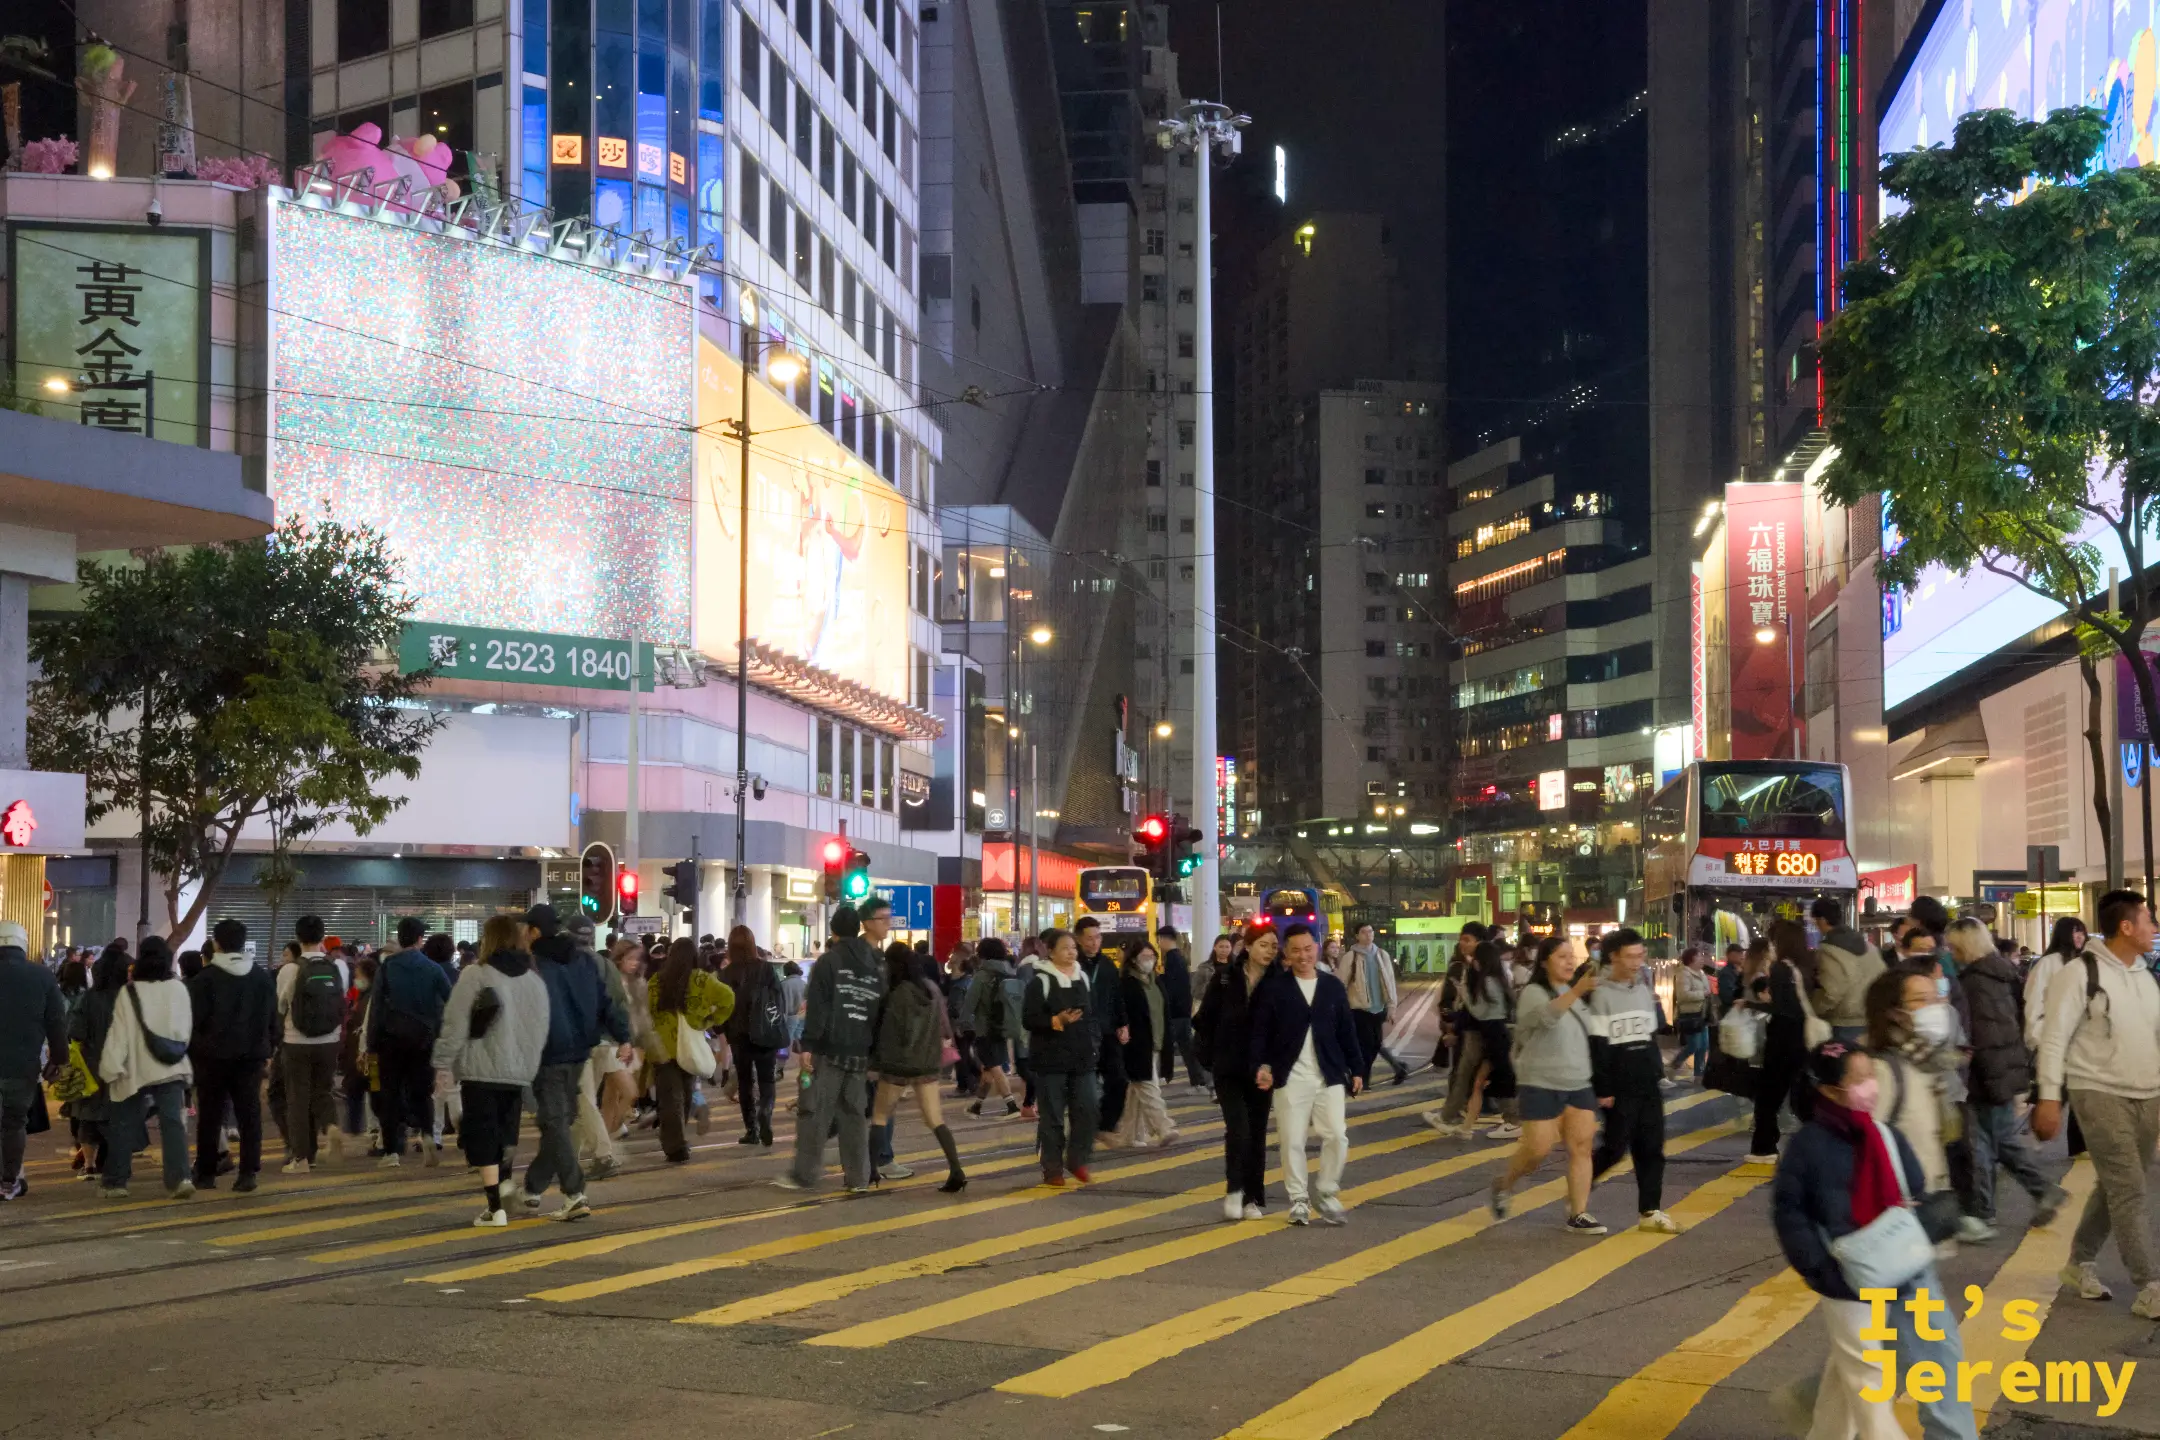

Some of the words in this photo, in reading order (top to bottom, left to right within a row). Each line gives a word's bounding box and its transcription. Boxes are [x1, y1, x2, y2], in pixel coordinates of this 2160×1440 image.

[1746, 521, 1774, 626] 六福珠寶
[1776, 569, 1787, 625] JEWELLERY
[485, 639, 556, 675] 2523
[566, 646, 631, 682] 1840
[2134, 714, 2142, 734] CITY
[1742, 839, 1802, 851] 九巴月票
[1734, 852, 1770, 869] 利安
[1776, 852, 1817, 875] 680
[1107, 901, 1121, 911] 25A
